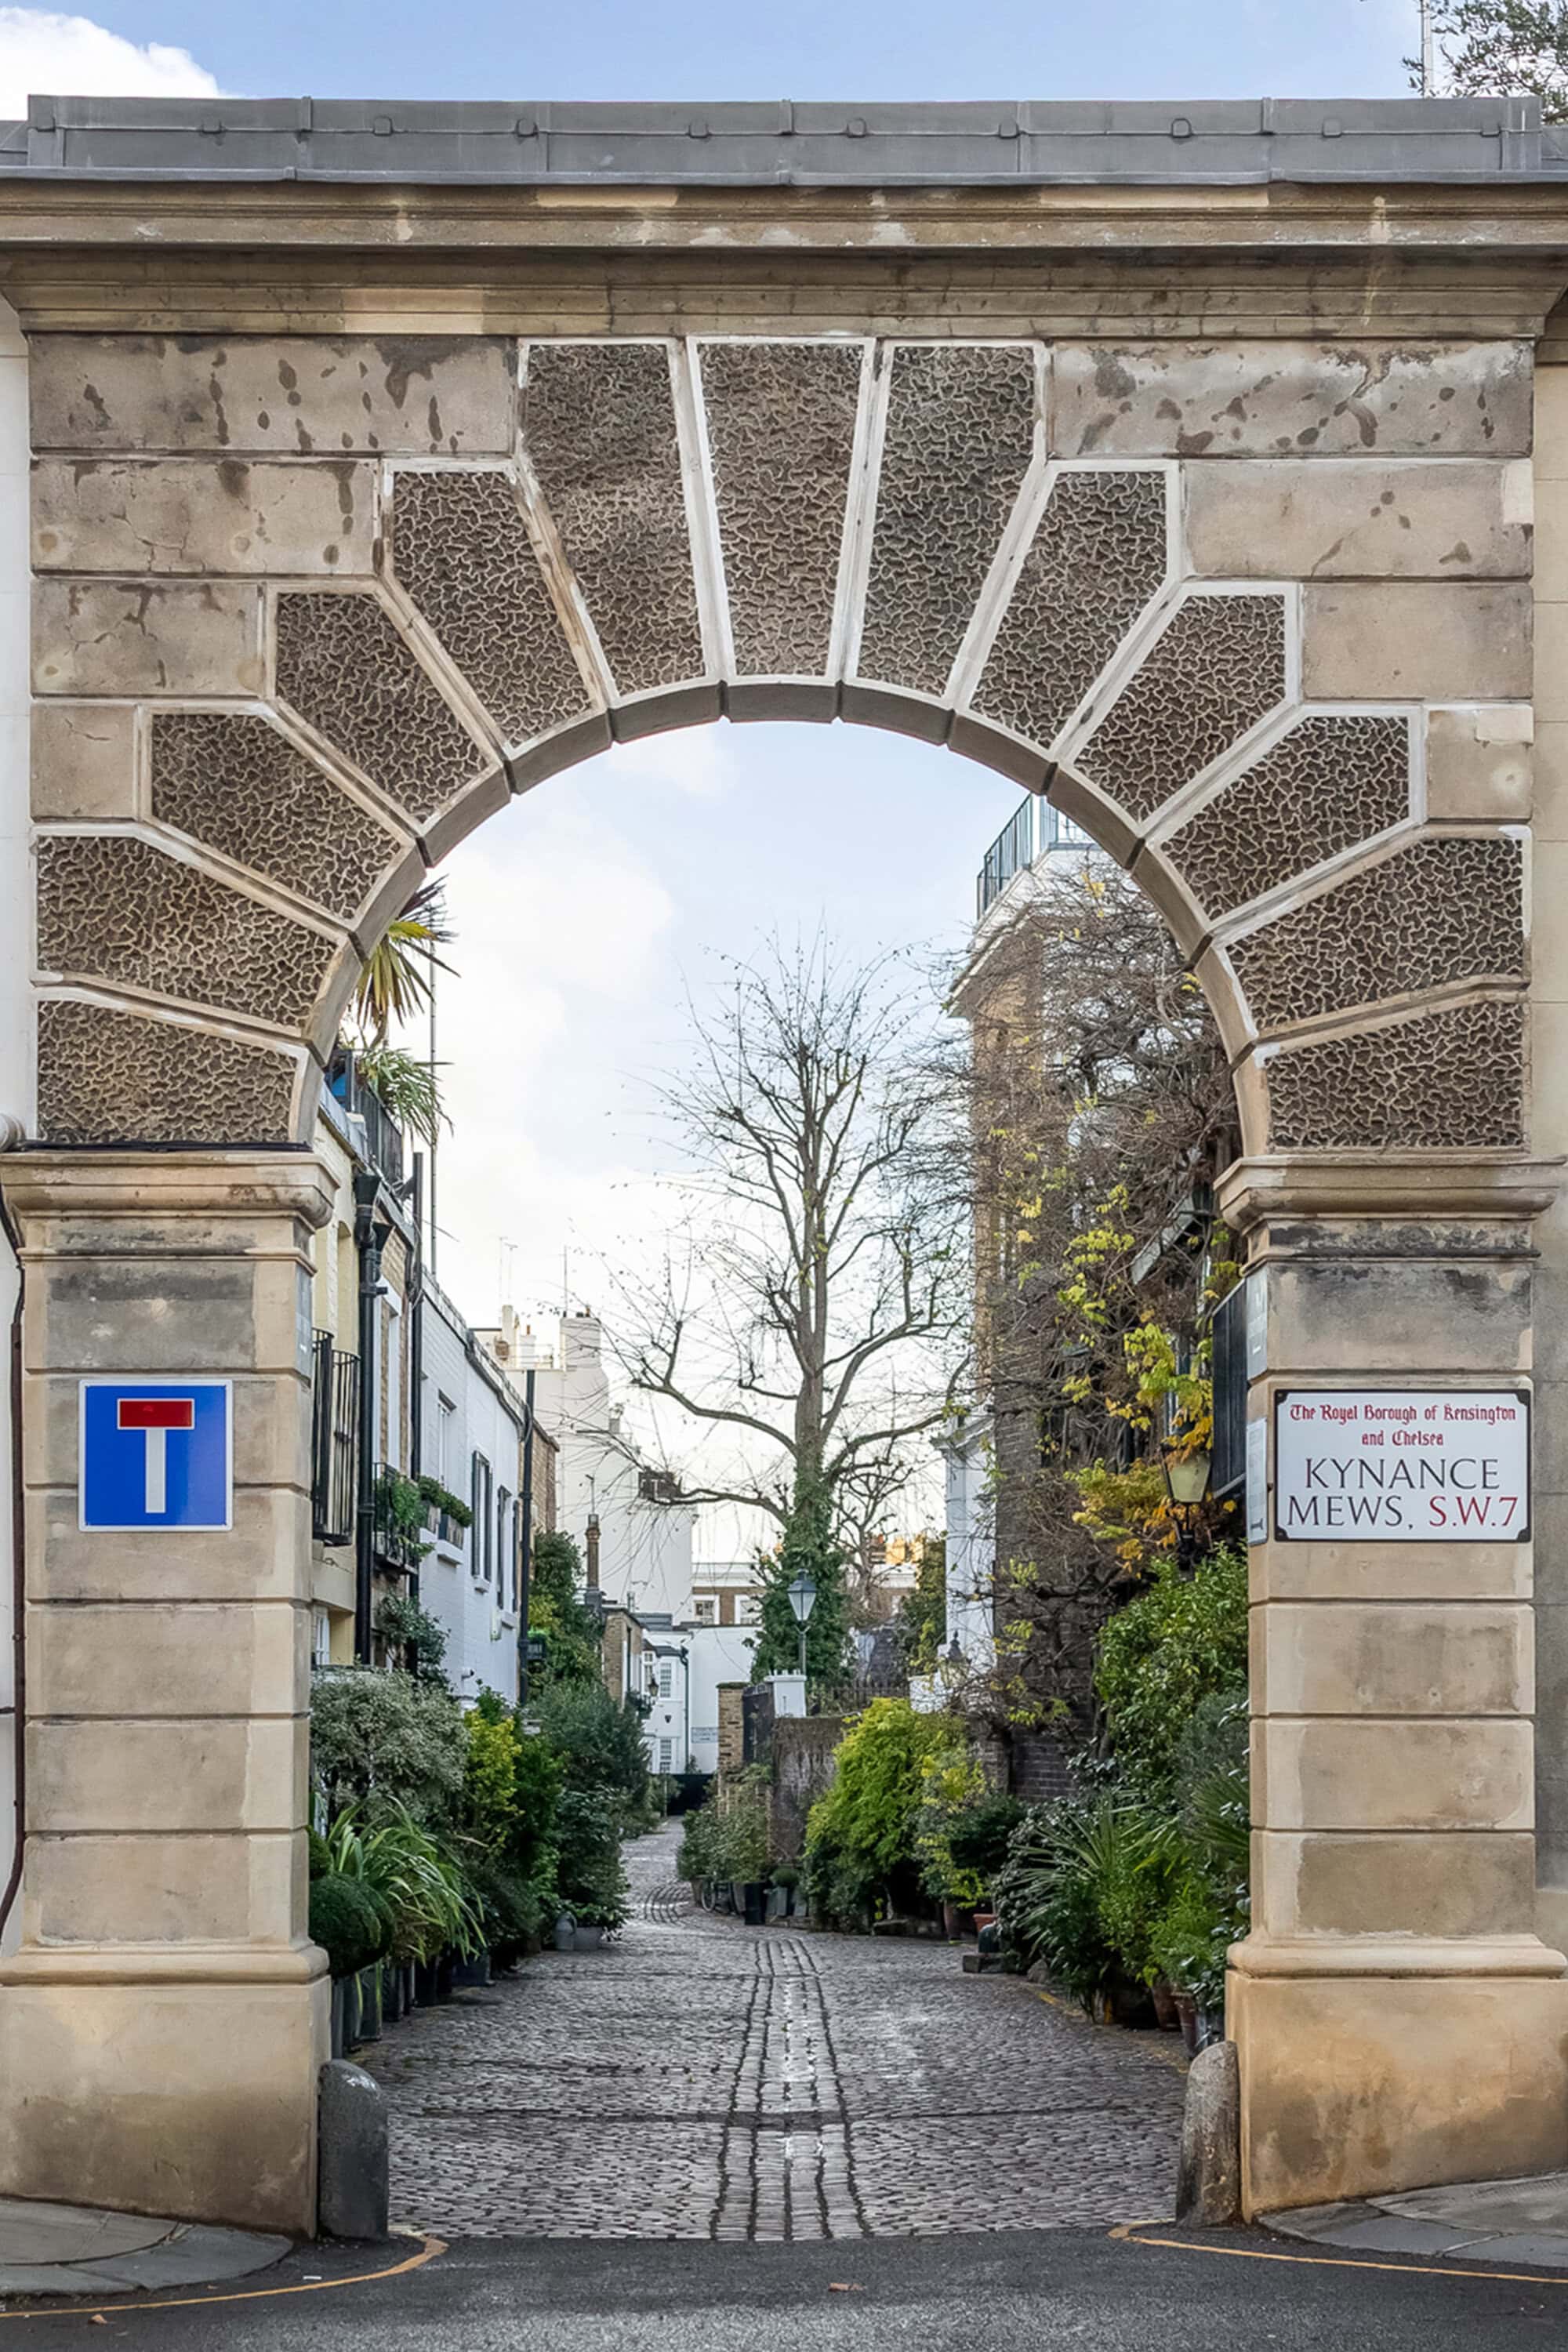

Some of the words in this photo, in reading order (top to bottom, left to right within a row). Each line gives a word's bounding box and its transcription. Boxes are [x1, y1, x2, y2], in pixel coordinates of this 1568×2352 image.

[1290, 1404, 1316, 1421] The
[1319, 1404, 1358, 1425] Royal
[1364, 1404, 1417, 1425] Borough
[1425, 1405, 1438, 1420] of
[1444, 1403, 1515, 1425] Kensington
[1362, 1430, 1384, 1446] and
[1392, 1430, 1443, 1446] Chelsea
[1305, 1457, 1499, 1490] KYNANCE
[1429, 1496, 1518, 1526] S.W.7
